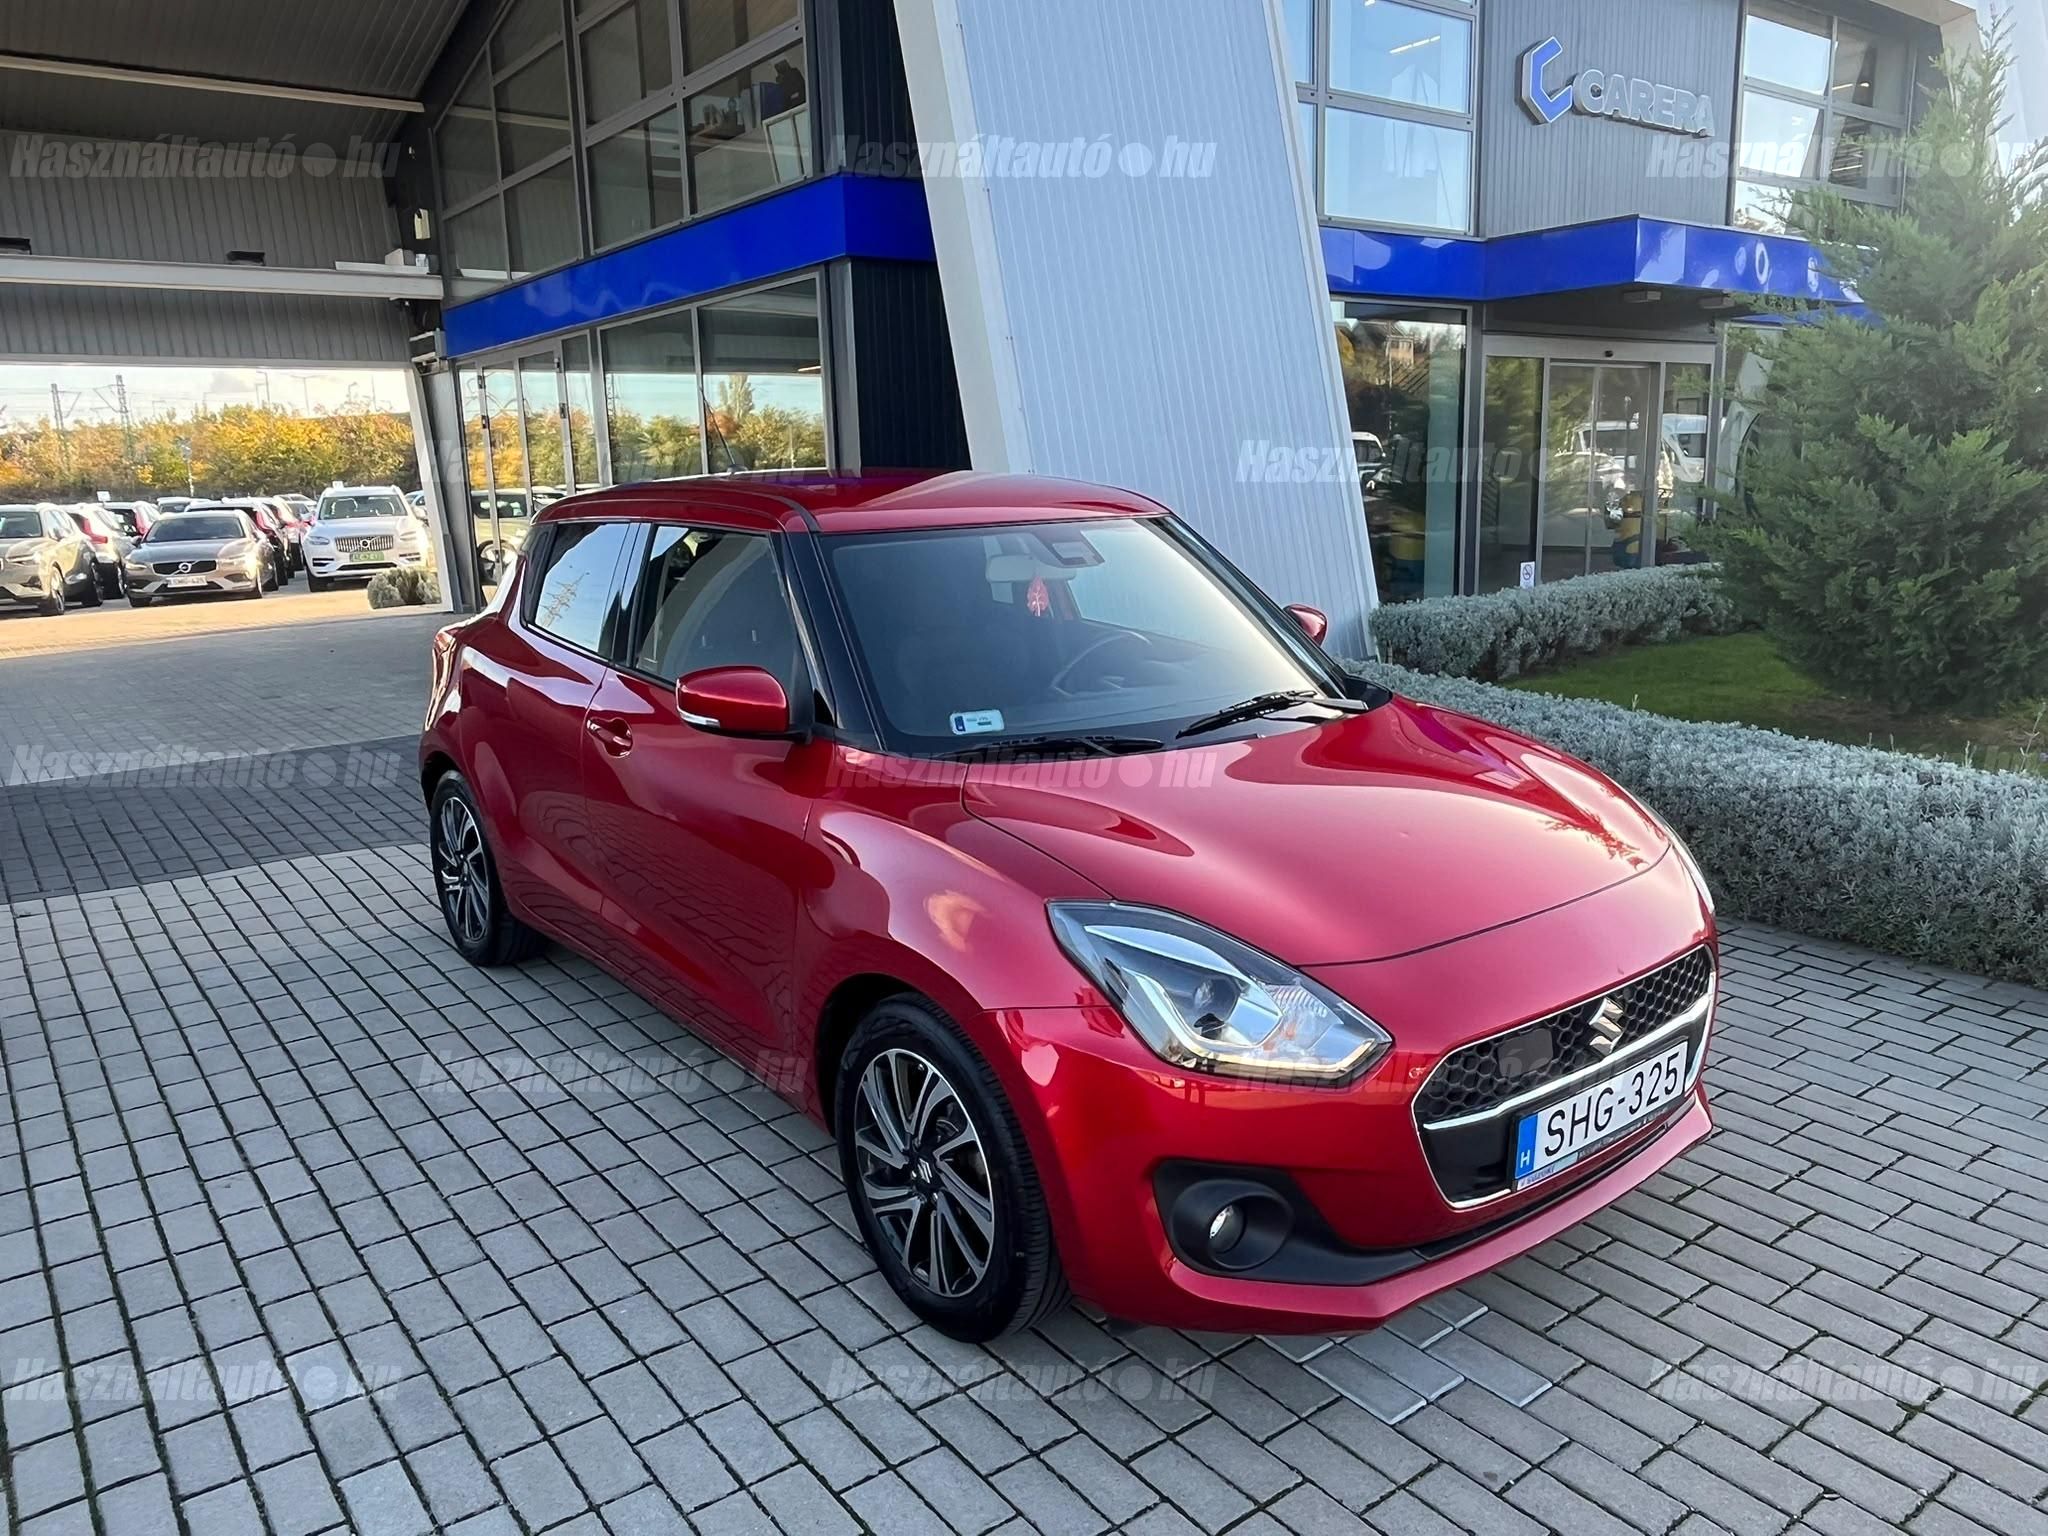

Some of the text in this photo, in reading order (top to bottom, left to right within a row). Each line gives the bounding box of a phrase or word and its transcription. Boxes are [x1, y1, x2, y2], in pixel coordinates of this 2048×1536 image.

[1577, 68, 1715, 136] CARERA
[1520, 1150, 1530, 1168] H
[1544, 1051, 1680, 1157] SHG-325
